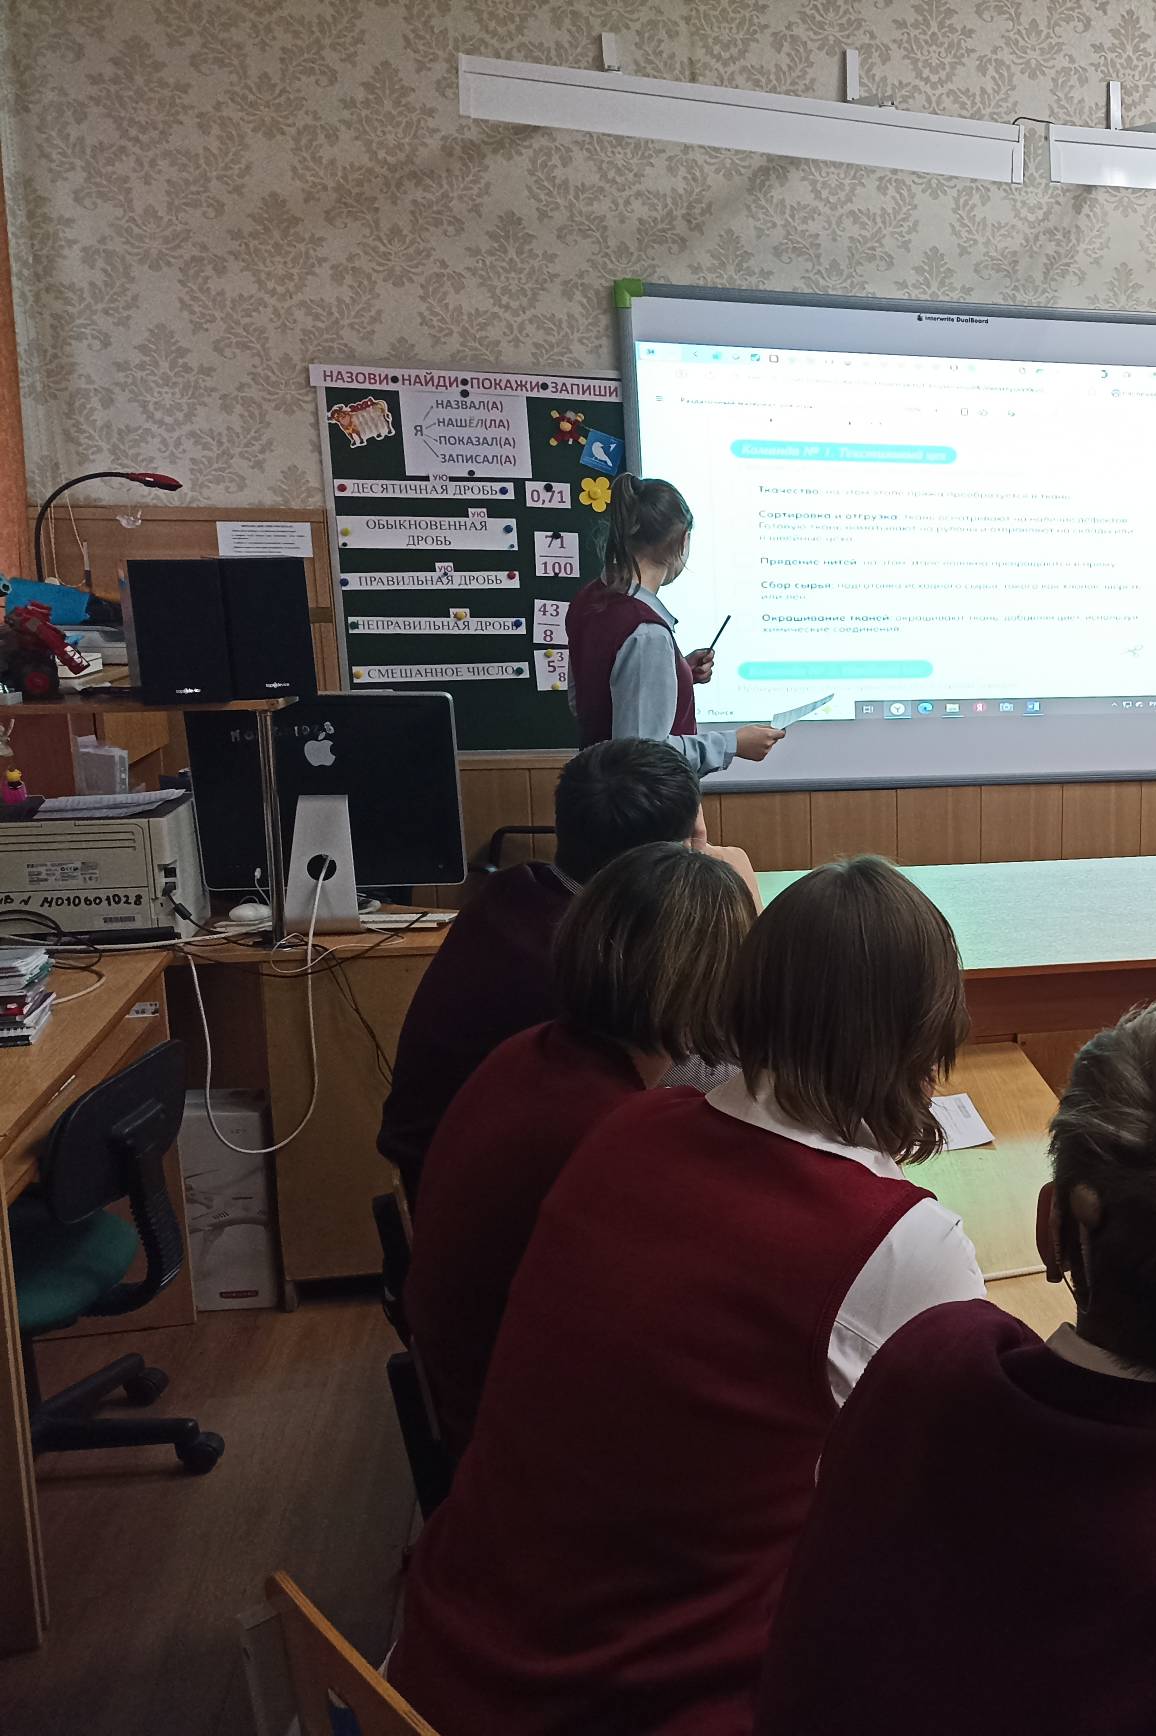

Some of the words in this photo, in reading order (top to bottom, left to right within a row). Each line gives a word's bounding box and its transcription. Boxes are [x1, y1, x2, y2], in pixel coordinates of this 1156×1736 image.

[322, 369, 390, 387] НАЗОВИ
[401, 371, 460, 391] НАЙДИ
[470, 377, 541, 393] ПОКАЖИ
[550, 381, 619, 398] ЗАПИШИ
[435, 399, 504, 413] НАЗВАЛ(А)
[413, 424, 424, 437] Я
[438, 435, 517, 449] ПОКАЗАЛ(А)
[440, 453, 517, 467] ЗАПИСАЛ(А)
[350, 482, 449, 496] ДЕСЯТИЧНАЯ
[452, 484, 499, 497] ДРОБЬ
[530, 489, 567, 506] 0,71
[366, 518, 488, 531] ОБЫКНОВЕННАЯ
[406, 535, 452, 547] ДРОБЬ
[544, 534, 566, 549] 71
[541, 560, 574, 576] 100
[358, 574, 455, 587] ПРАВИЛЬНАЯ
[457, 573, 503, 587] ДРОБЬ
[538, 603, 561, 617] 43
[356, 617, 471, 631] НЕПРАВИЛЬНАЯ
[542, 628, 554, 643] 8
[555, 651, 564, 662] 3
[367, 667, 464, 680] СМЕШАННОЕ
[466, 664, 516, 679] ЧИСЛО
[547, 660, 557, 674] 5
[558, 671, 567, 682] 8
